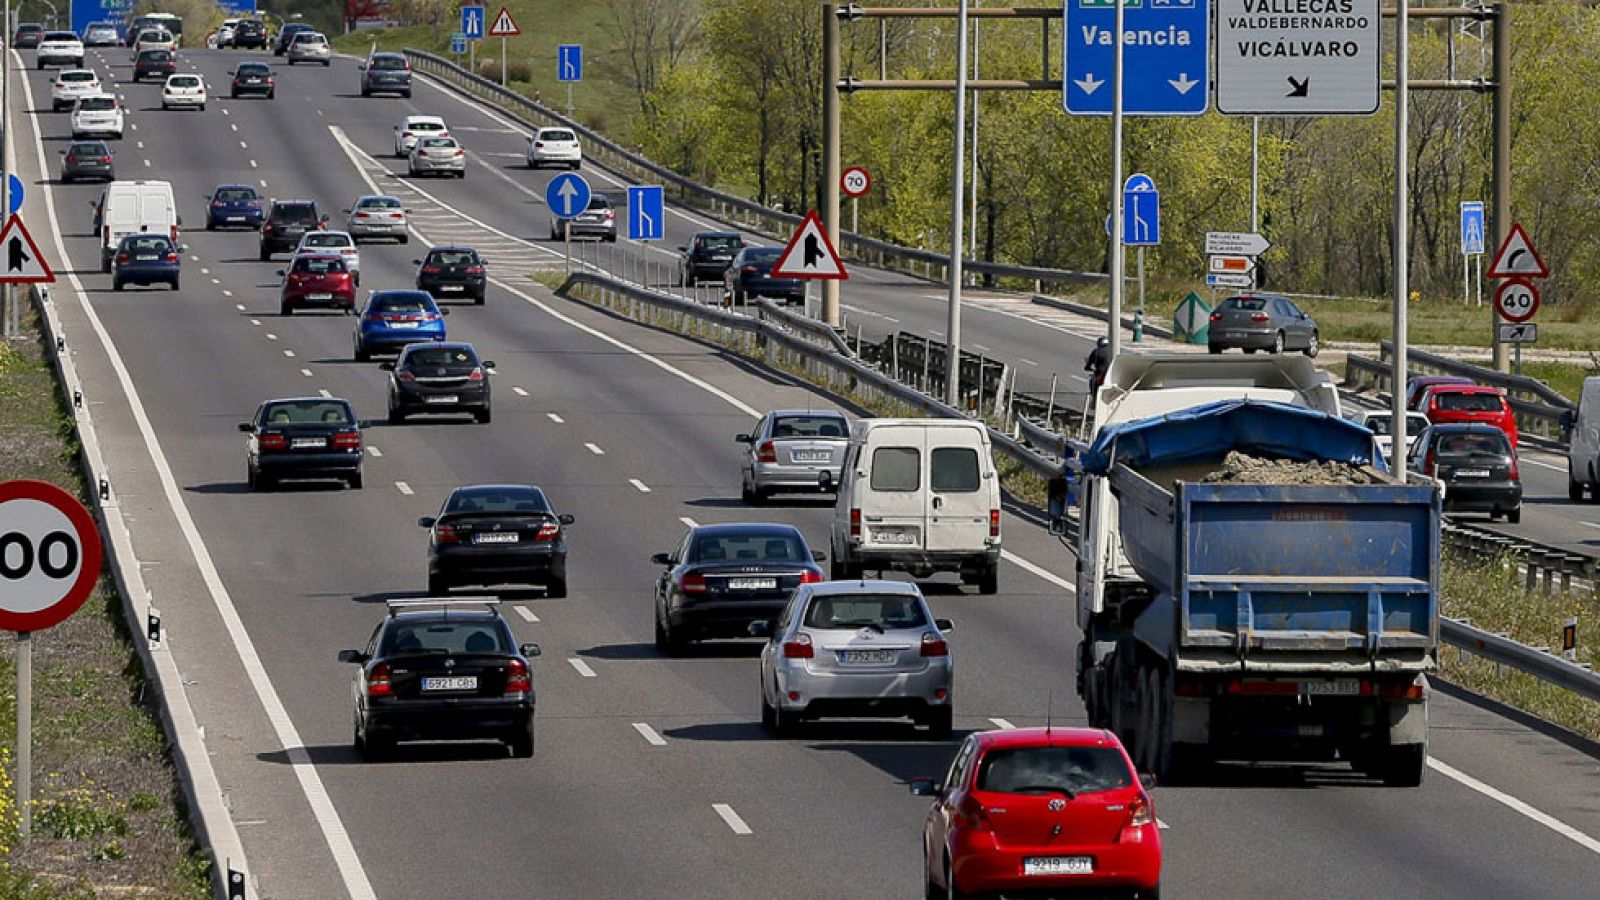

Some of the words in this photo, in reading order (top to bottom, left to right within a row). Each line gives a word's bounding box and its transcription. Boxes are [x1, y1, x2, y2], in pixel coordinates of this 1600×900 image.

[1243, 0, 1353, 13] VALLECAS
[1228, 17, 1368, 29] VALDEBERNARDO
[1081, 25, 1191, 45] Vaencia
[1238, 36, 1359, 57] VICÁLVARO
[847, 177, 863, 187] 70
[1504, 293, 1531, 308] 40
